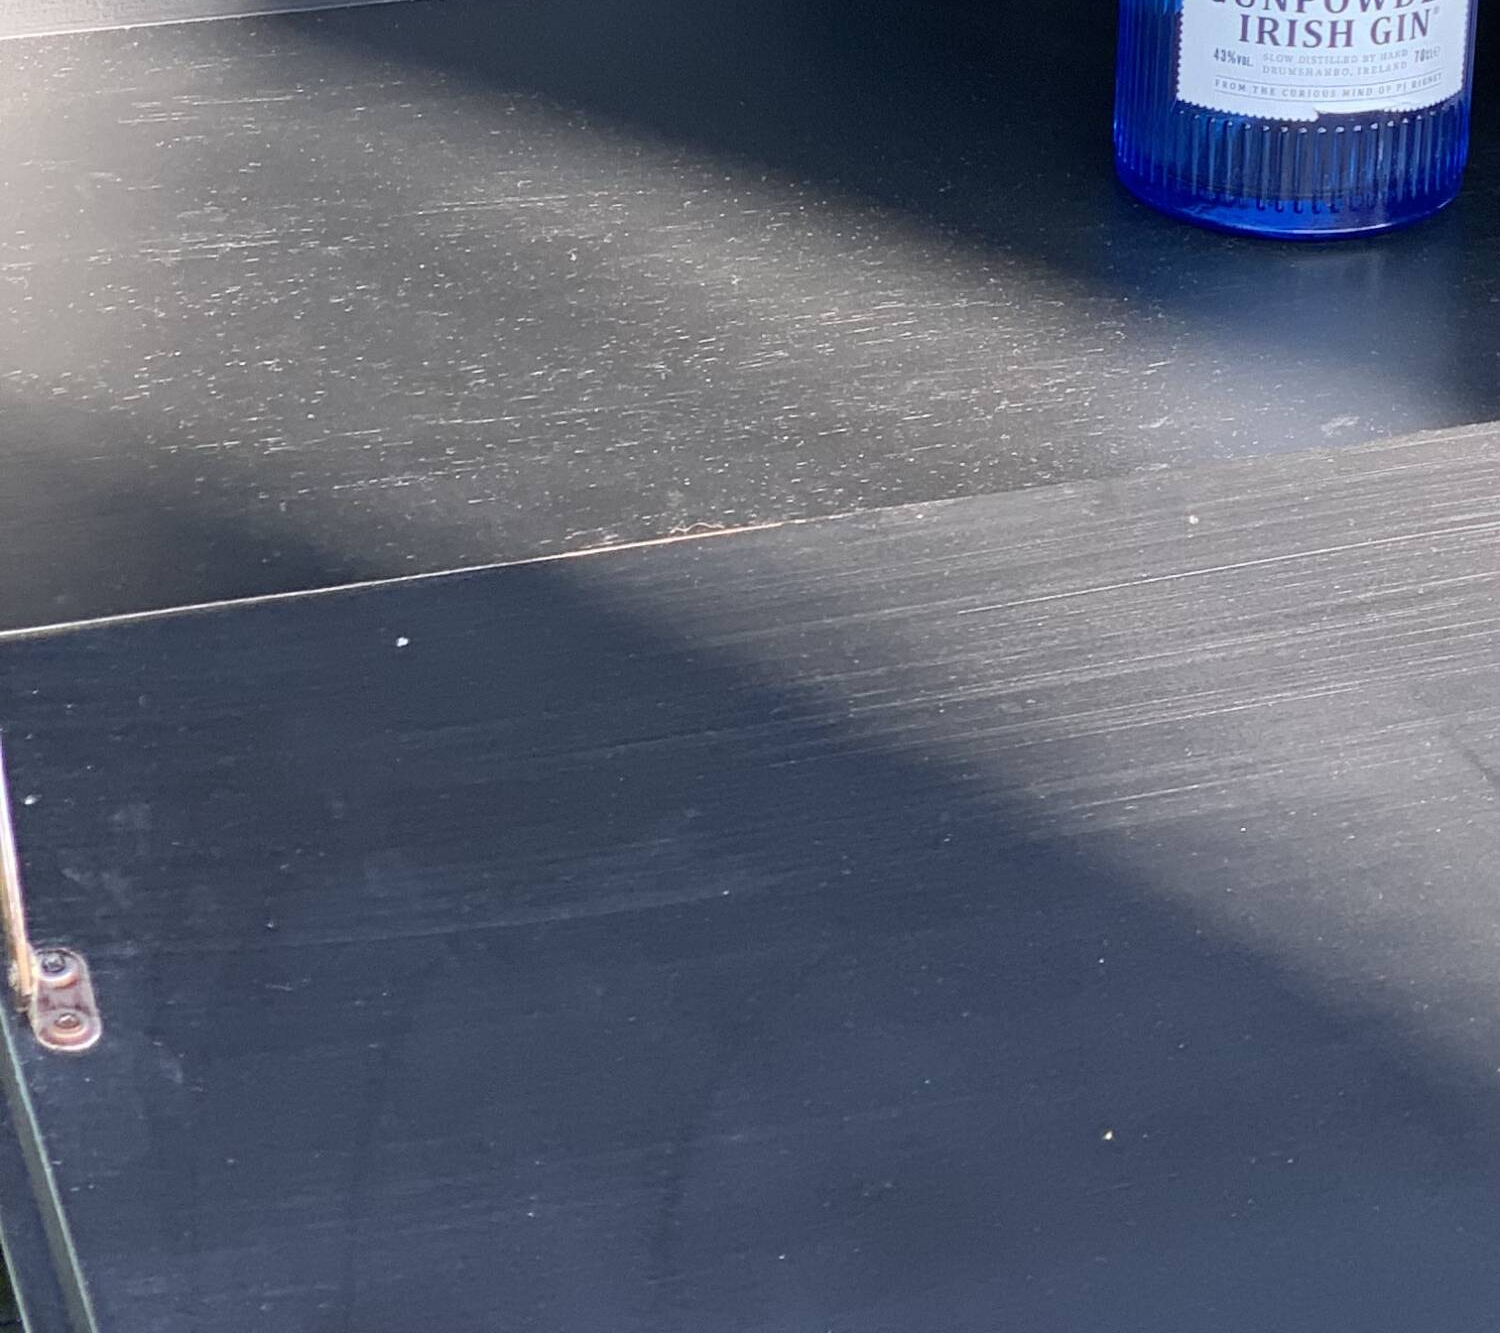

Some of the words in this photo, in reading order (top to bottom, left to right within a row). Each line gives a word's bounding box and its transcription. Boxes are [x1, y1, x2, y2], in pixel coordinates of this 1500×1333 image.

[1238, 14, 1355, 49] IRISH
[1262, 53, 1294, 63] SLOW
[1215, 79, 1246, 92] FROM
[1252, 86, 1276, 96] THE
[1343, 87, 1373, 97] MIND
